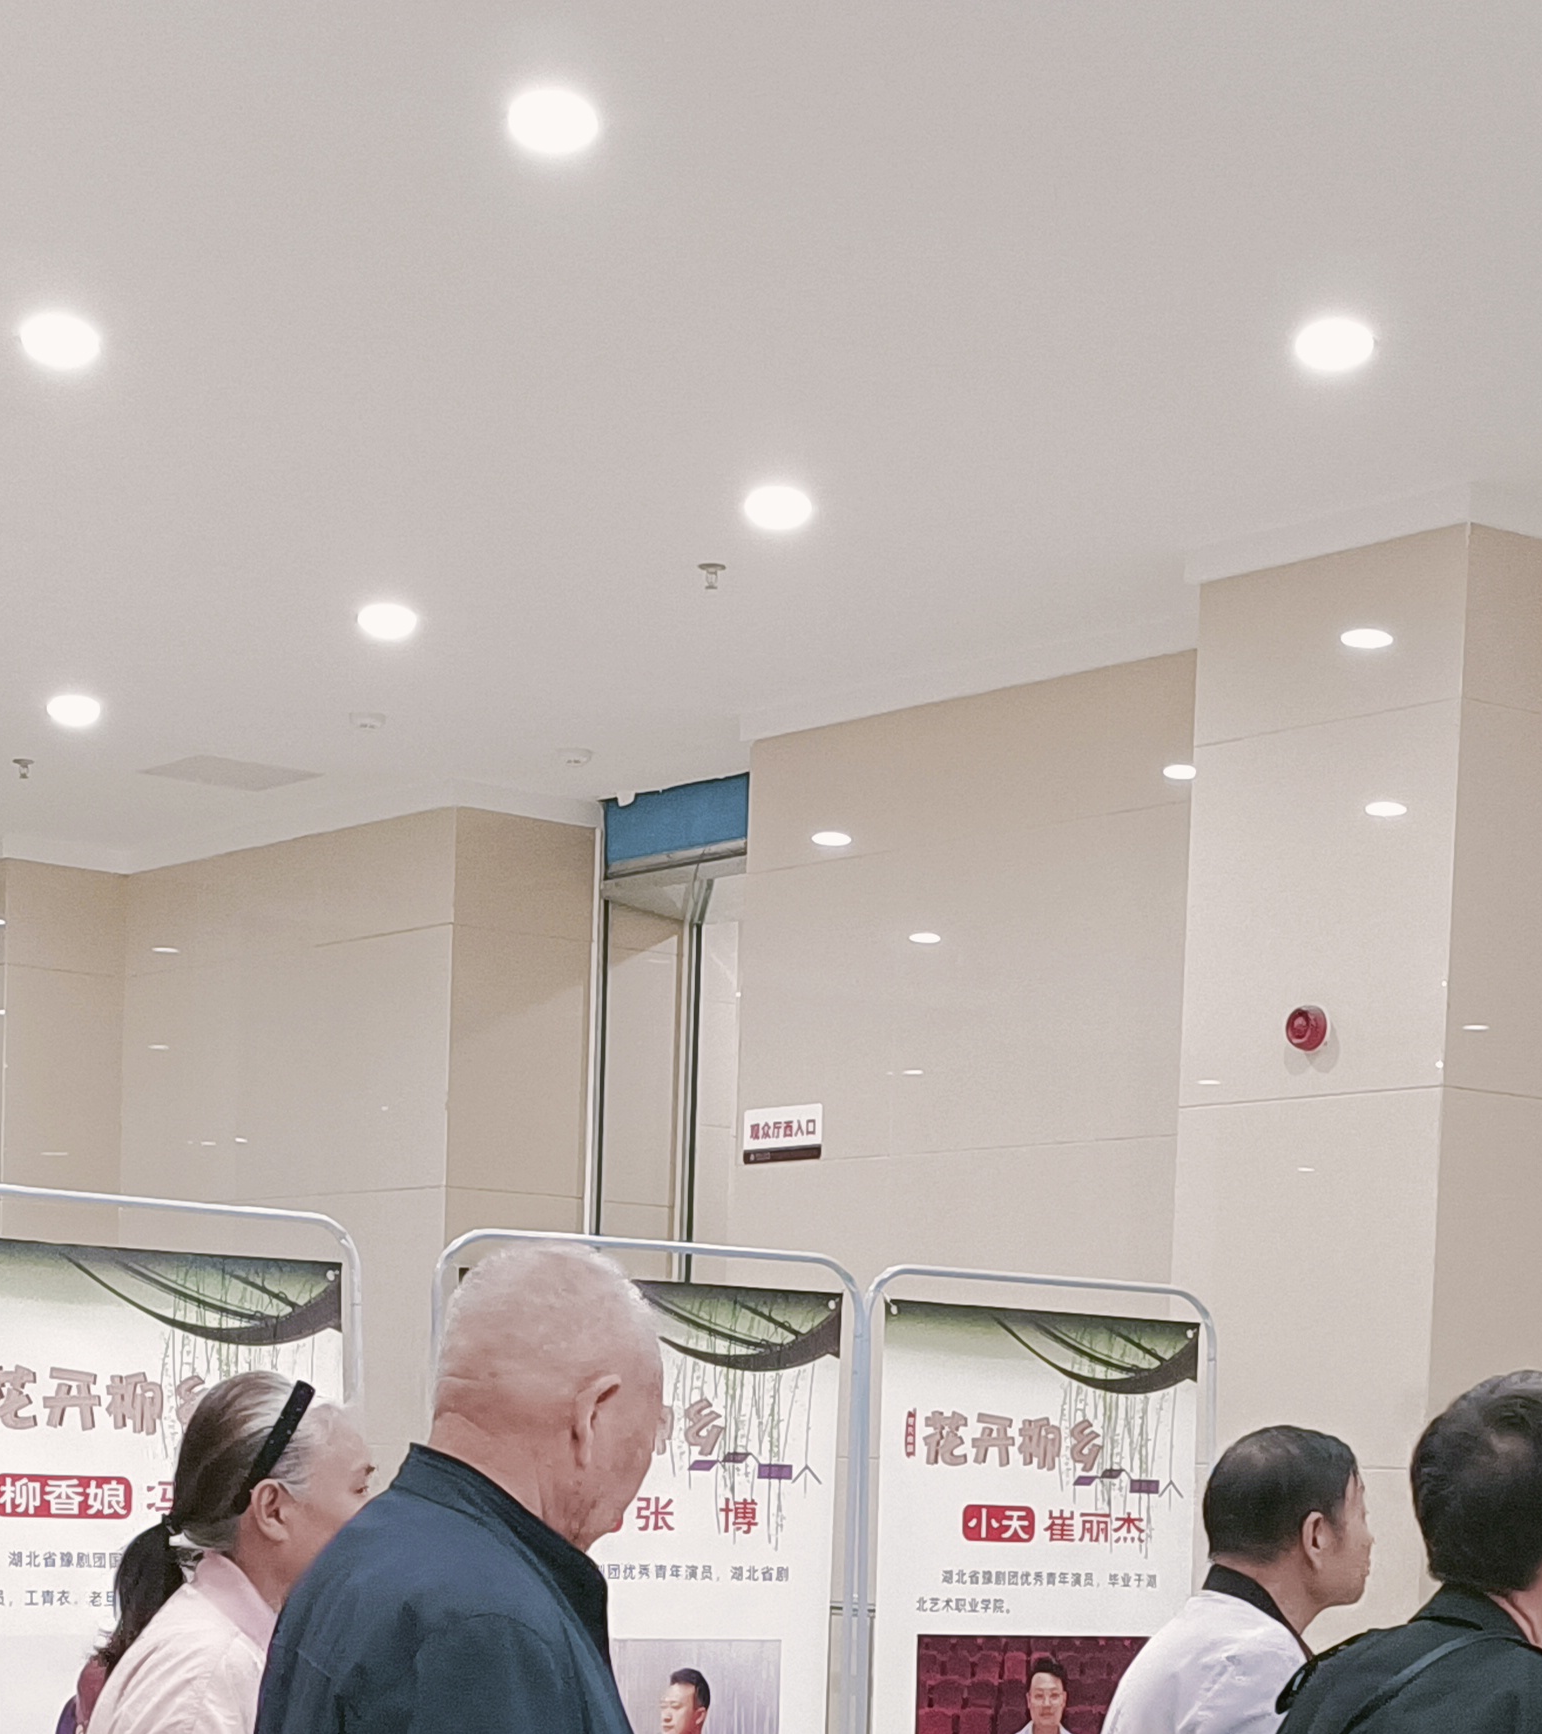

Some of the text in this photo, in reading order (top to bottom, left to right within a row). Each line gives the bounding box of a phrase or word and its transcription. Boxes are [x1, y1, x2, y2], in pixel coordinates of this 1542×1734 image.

[750, 1119, 816, 1140] 观众厅西入口
[923, 1410, 1103, 1472] 花开柳乡
[635, 1496, 759, 1534] 张 博
[967, 1508, 1146, 1544] 小天 崔丽杰
[598, 1563, 790, 1583] 团优秀青年演员，湖北省剧
[916, 1596, 1012, 1615] 北艺术职业学院。
